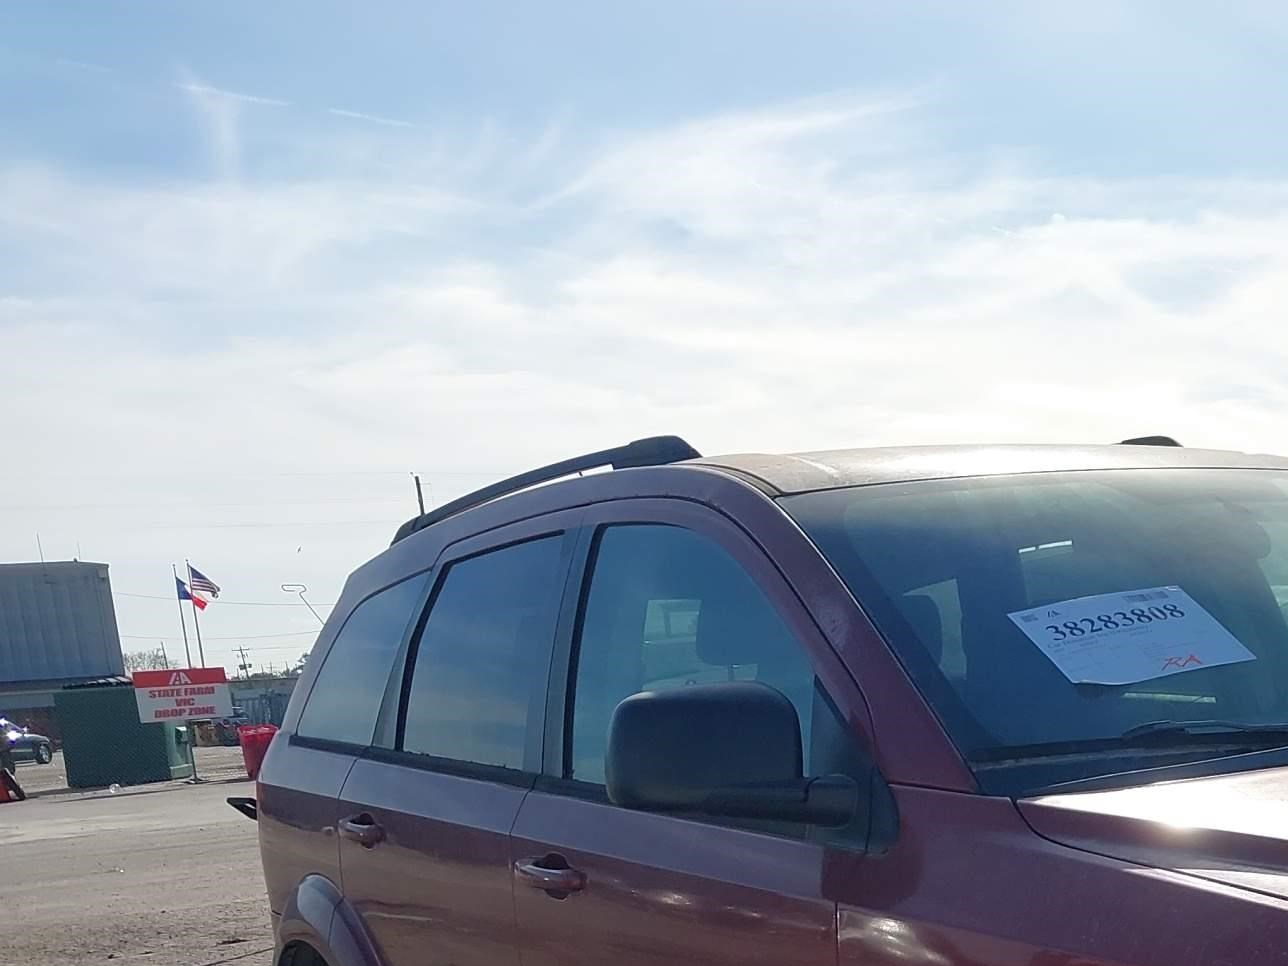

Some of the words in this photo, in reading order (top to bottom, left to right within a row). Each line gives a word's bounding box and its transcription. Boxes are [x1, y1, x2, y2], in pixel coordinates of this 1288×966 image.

[1046, 604, 1184, 641] 38283808
[148, 688, 183, 699] STATE
[184, 686, 215, 696] FARM
[154, 708, 186, 719] DROP
[187, 705, 216, 716] ZONE
